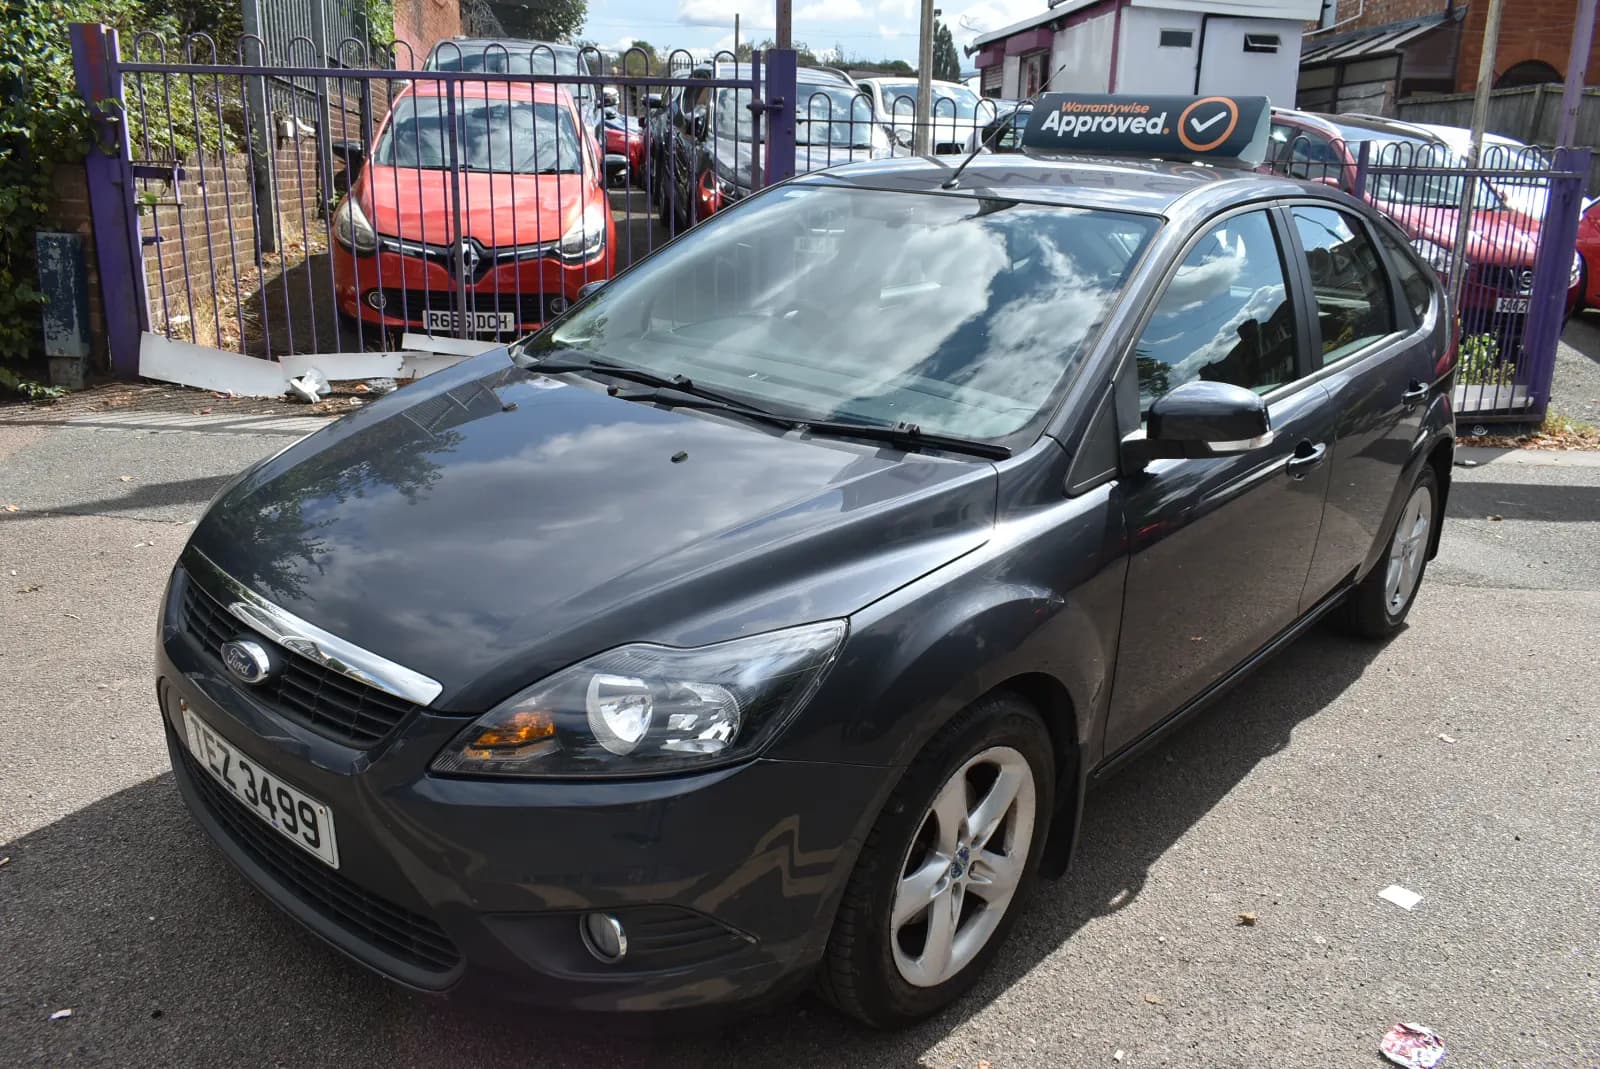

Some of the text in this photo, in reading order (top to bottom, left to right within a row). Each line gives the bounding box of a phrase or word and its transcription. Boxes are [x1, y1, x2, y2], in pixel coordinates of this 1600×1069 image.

[1061, 101, 1150, 116] Warrantywise
[1041, 110, 1170, 137] Approved.
[476, 314, 508, 329] DCH
[227, 647, 252, 675] Ford
[239, 760, 321, 849] 3499
